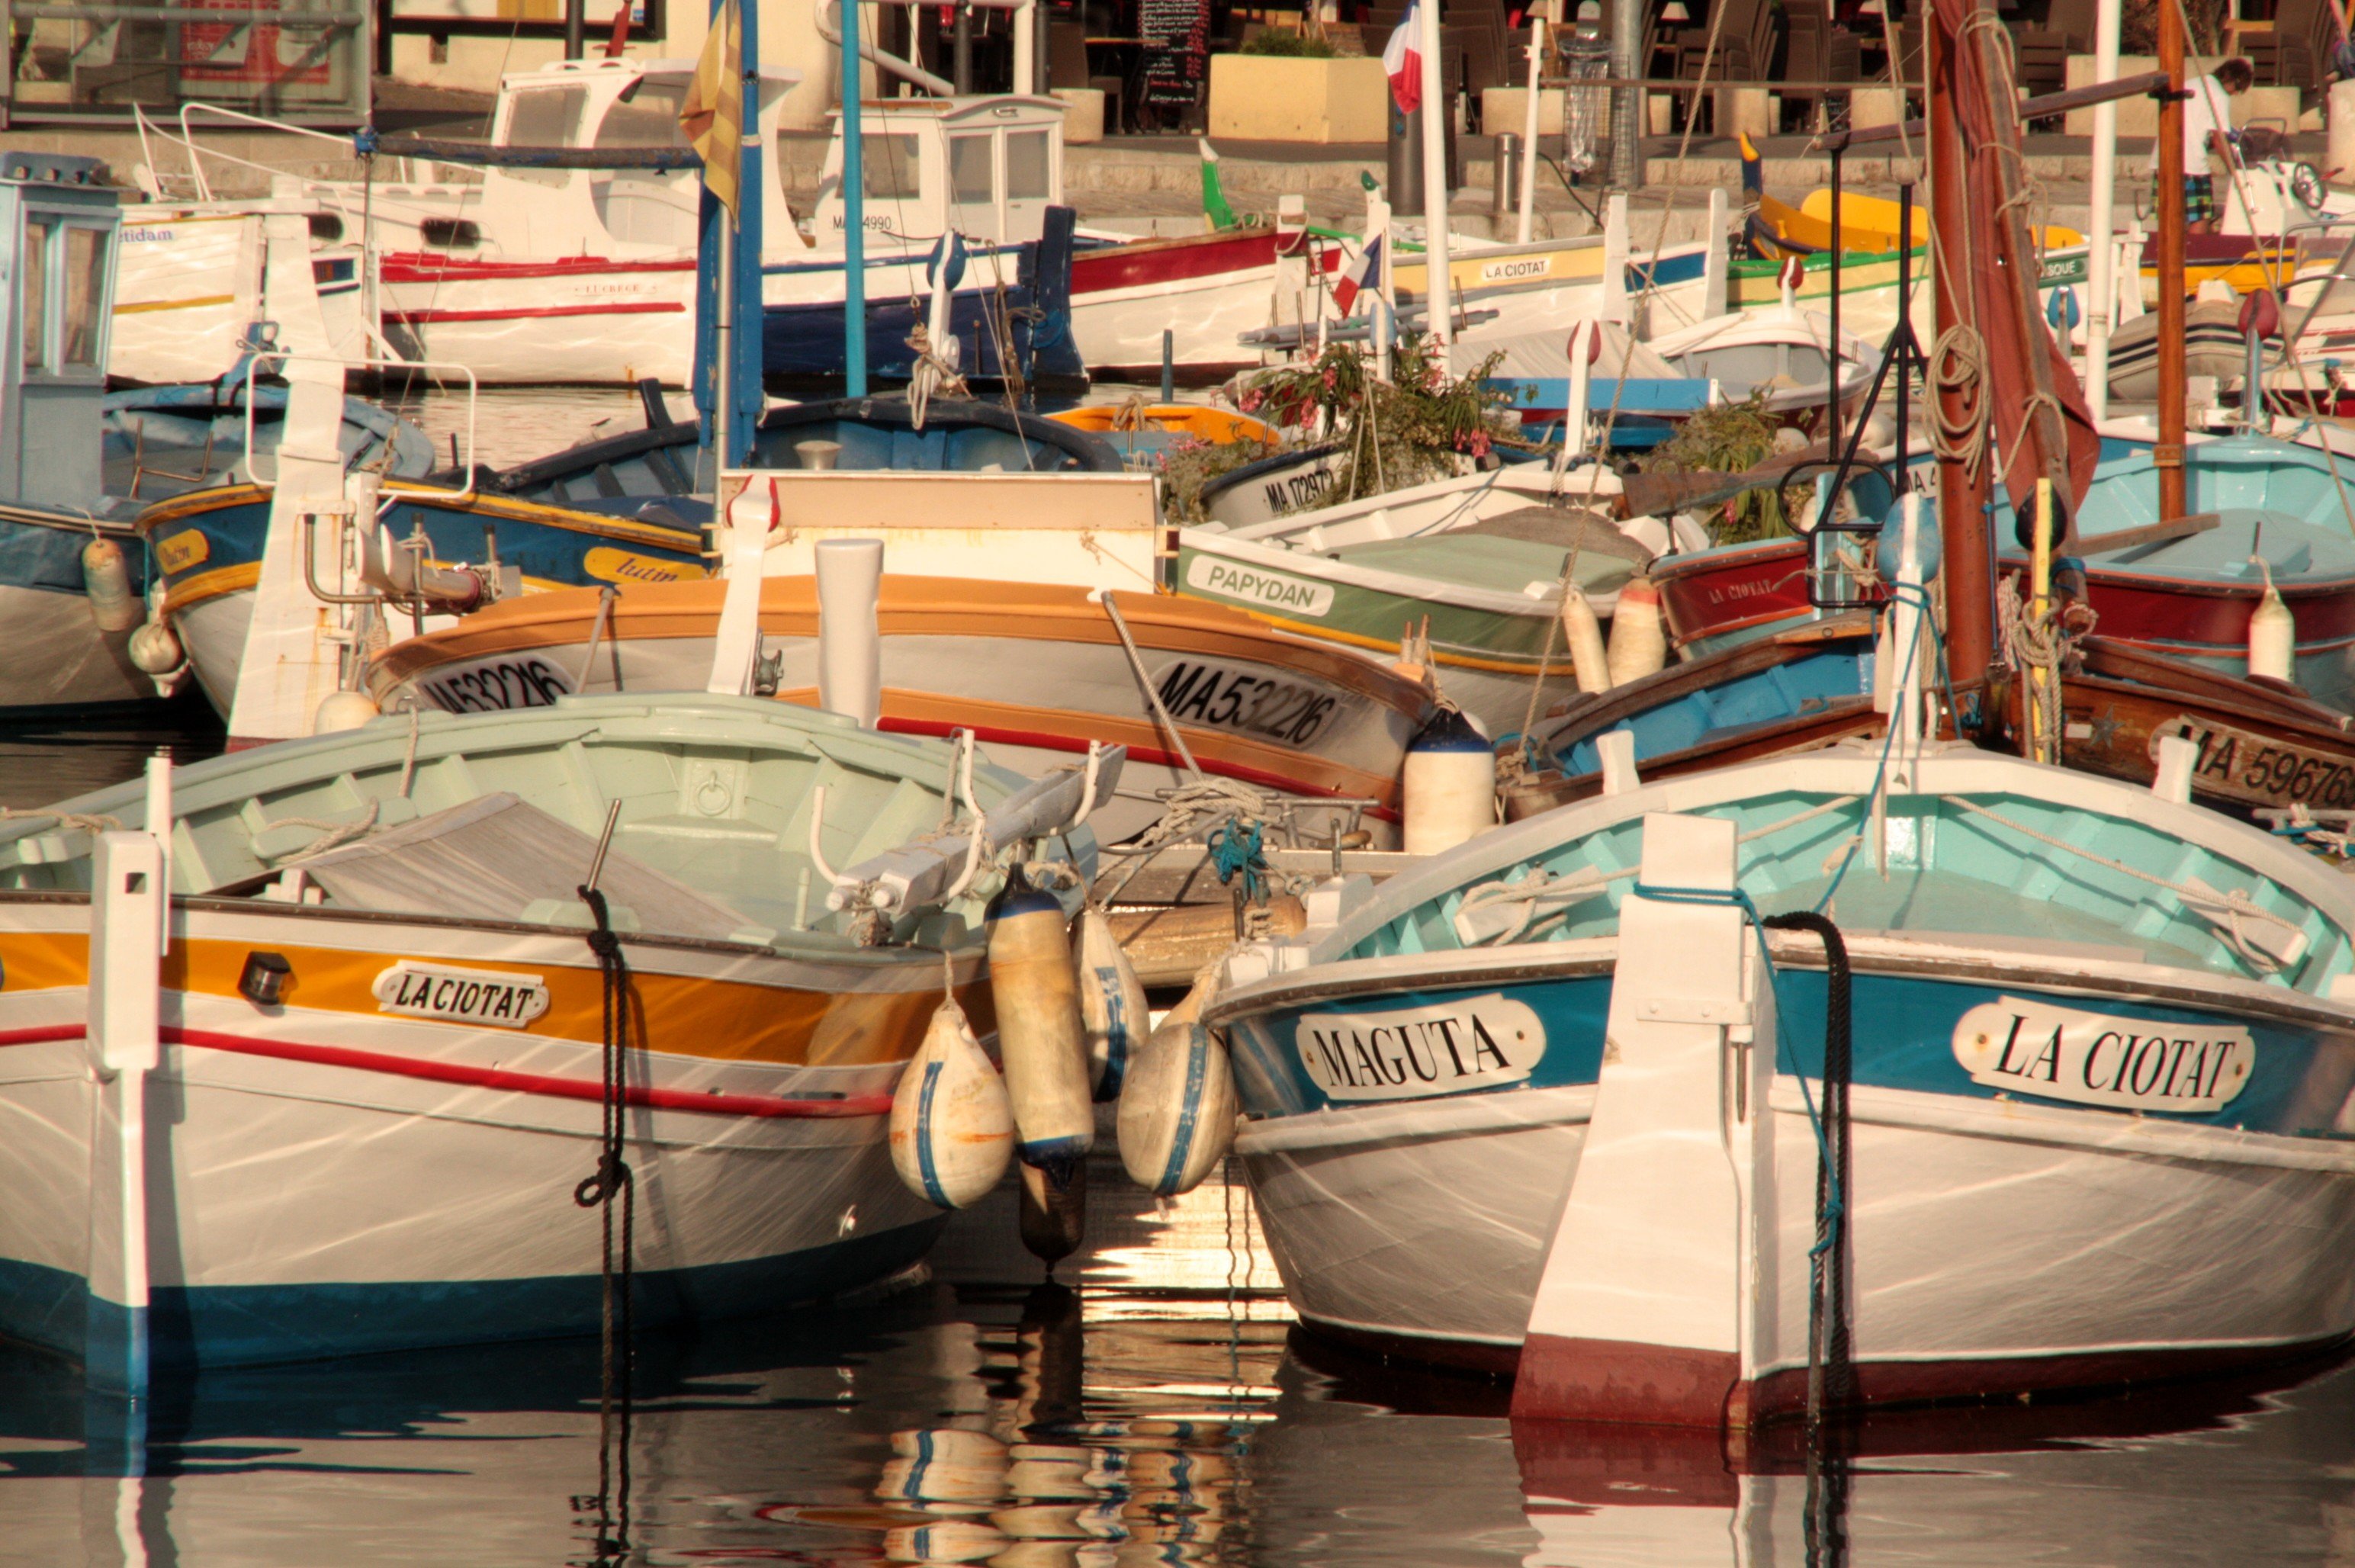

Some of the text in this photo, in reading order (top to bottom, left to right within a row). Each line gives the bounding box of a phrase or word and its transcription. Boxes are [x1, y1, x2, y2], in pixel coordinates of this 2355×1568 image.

[863, 215, 892, 230] 4990
[1486, 260, 1545, 278] LA CIOTAT
[1265, 482, 1290, 513] MA
[1208, 565, 1316, 608] PAPYDAN
[1728, 579, 1772, 600] CIOTAT
[1148, 662, 1336, 744] MA532216
[2245, 747, 2355, 806] 59676
[1312, 1014, 1512, 1087] MAGUTA
[1992, 1014, 2237, 1098] LA CIOTAT
